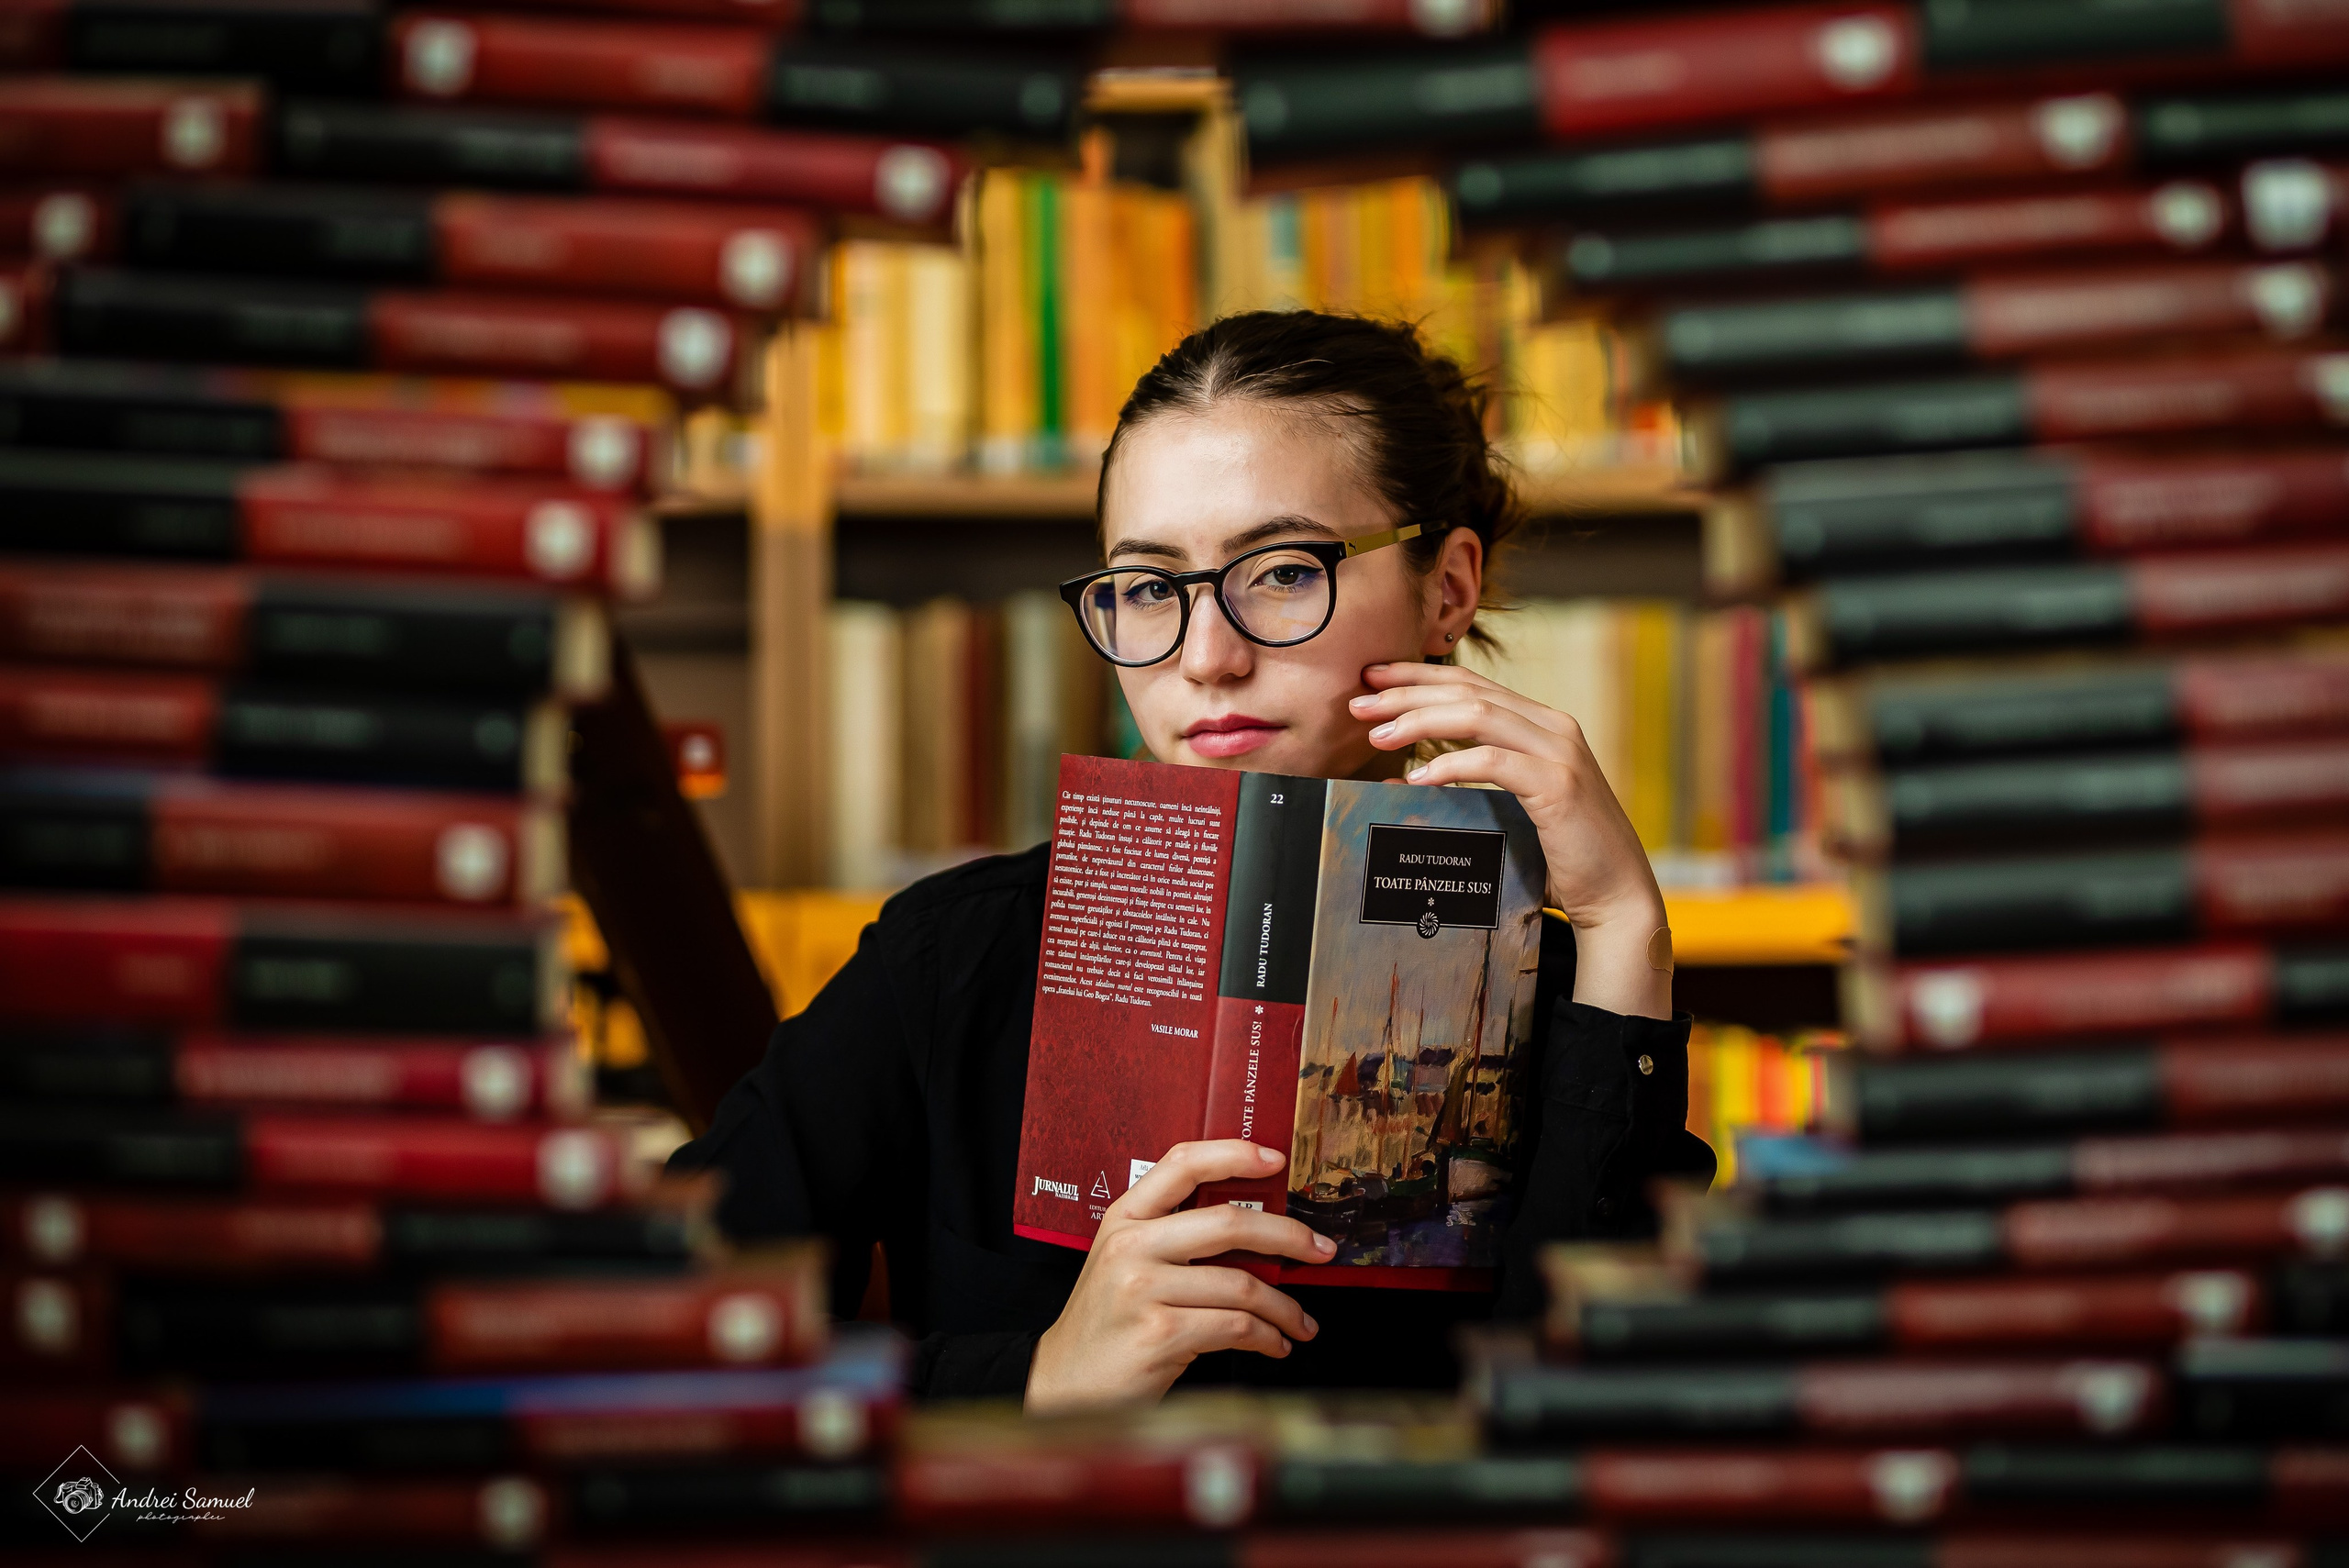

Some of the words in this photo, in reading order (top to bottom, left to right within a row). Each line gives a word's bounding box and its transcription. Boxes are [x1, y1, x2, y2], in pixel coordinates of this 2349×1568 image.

[1270, 794, 1284, 805] 22
[1399, 853, 1425, 864] RADU
[1426, 855, 1472, 867] TUDORAN
[1374, 876, 1412, 890] TOATE
[1414, 876, 1465, 893] PÂNZELE
[1466, 881, 1492, 895] SUS!
[1259, 903, 1273, 955] TUDORAN
[1256, 958, 1268, 988] RADU
[1151, 1023, 1173, 1035] VASILE
[1174, 1027, 1198, 1039] MORAR
[1251, 1020, 1263, 1047] SUS!
[1243, 1049, 1260, 1103] PÂNZELE
[1031, 1175, 1079, 1196] JURNALUL
[1088, 1204, 1107, 1212] EDITUR
